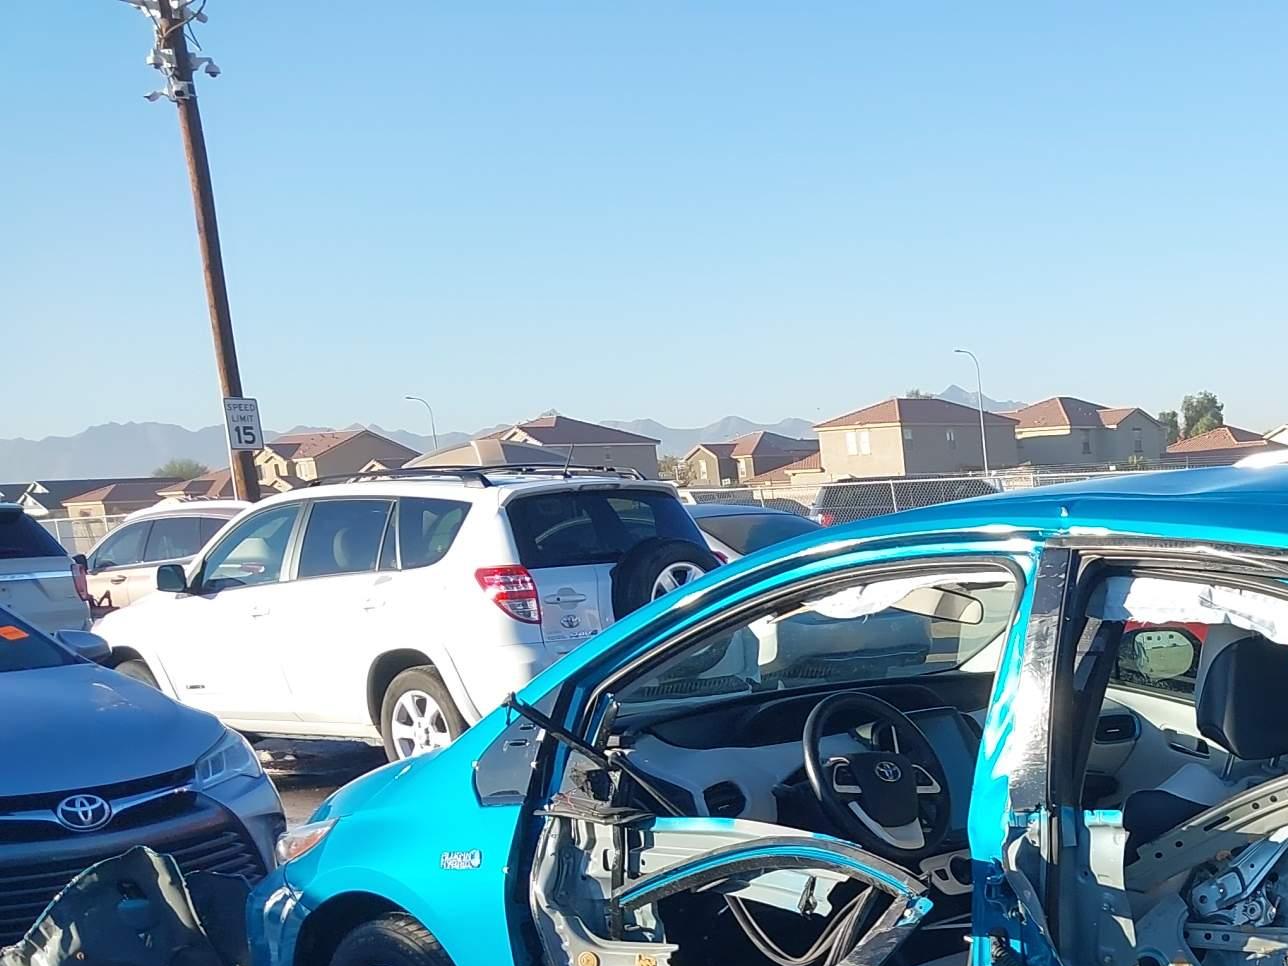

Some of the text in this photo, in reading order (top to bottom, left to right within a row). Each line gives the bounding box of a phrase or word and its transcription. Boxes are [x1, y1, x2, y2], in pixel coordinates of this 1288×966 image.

[227, 403, 256, 412] SPEED
[231, 414, 254, 423] LIMIT
[234, 425, 256, 445] 15
